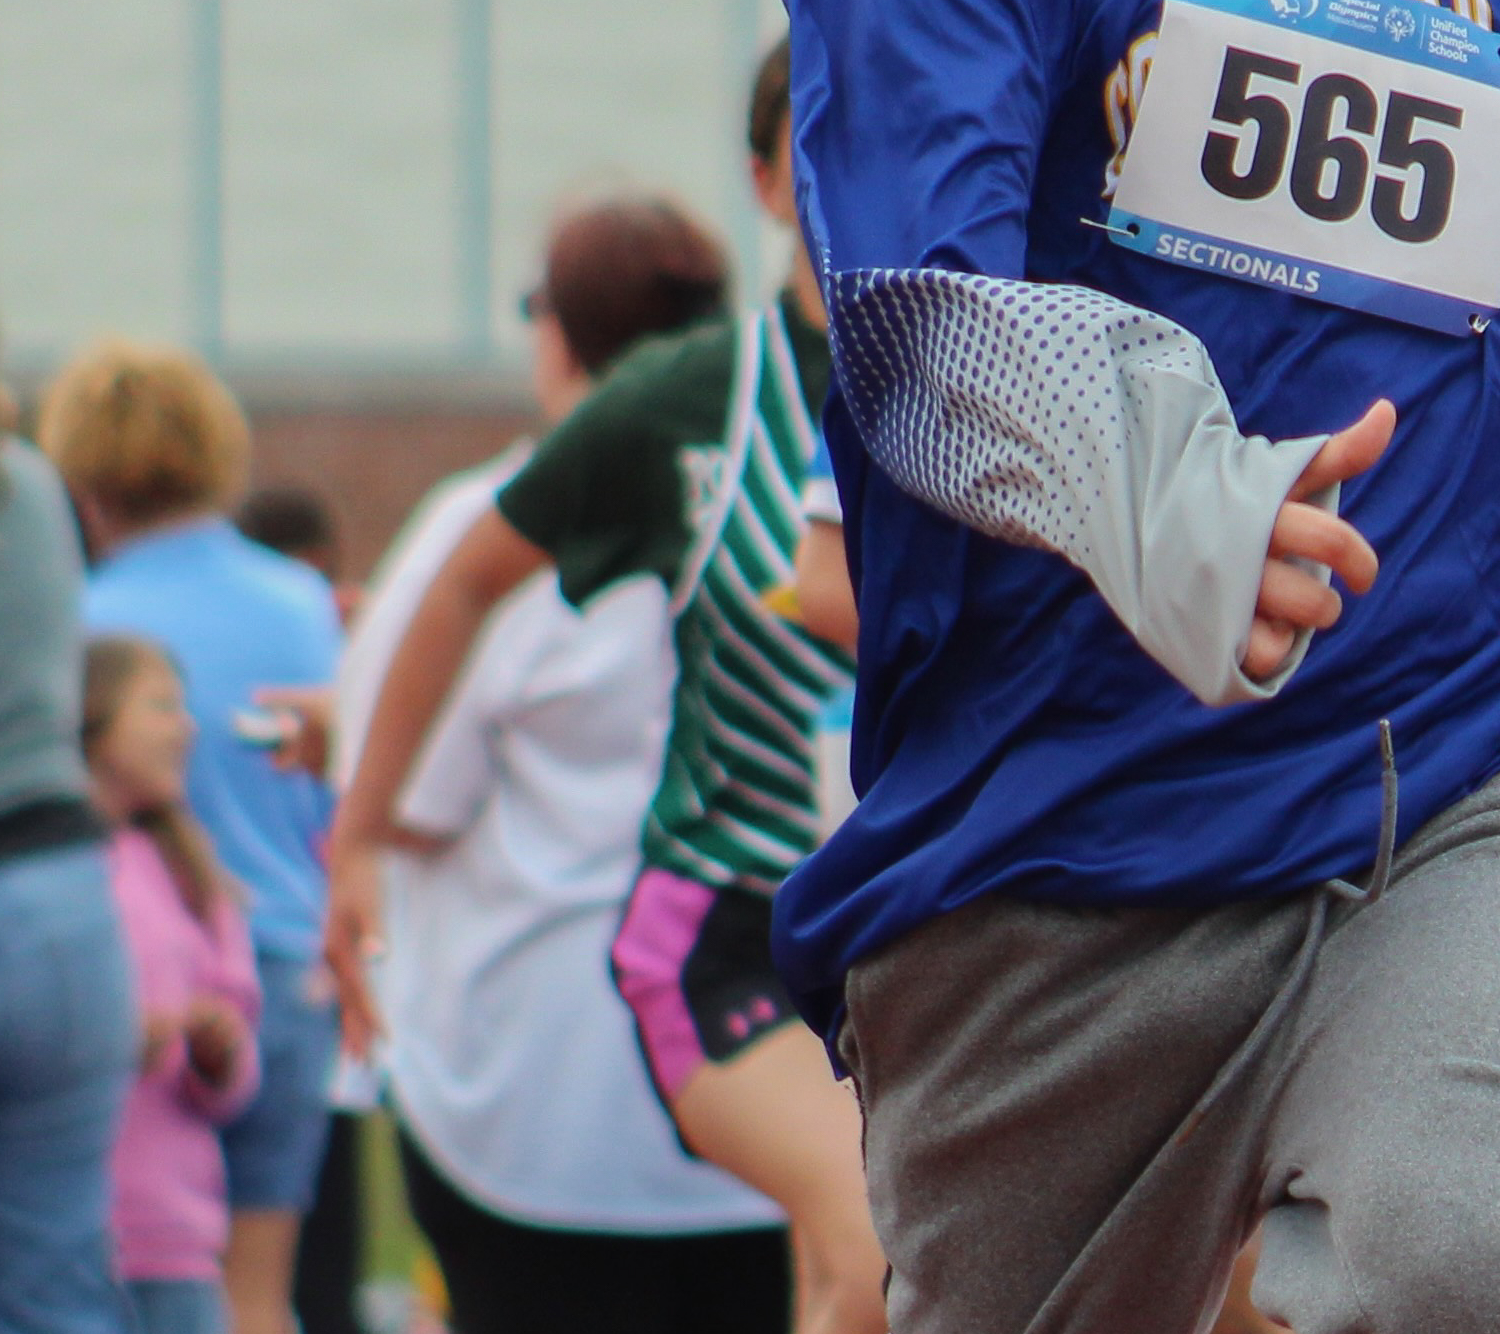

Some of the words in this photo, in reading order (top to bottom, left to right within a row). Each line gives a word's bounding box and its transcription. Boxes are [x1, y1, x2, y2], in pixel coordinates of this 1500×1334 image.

[1328, 1, 1379, 23] Olympics
[1431, 16, 1468, 38] Unified
[1428, 41, 1468, 63] Schools
[1430, 29, 1480, 54] Champion
[1200, 44, 1464, 244] 565
[1156, 233, 1321, 294] SECTIONALS
